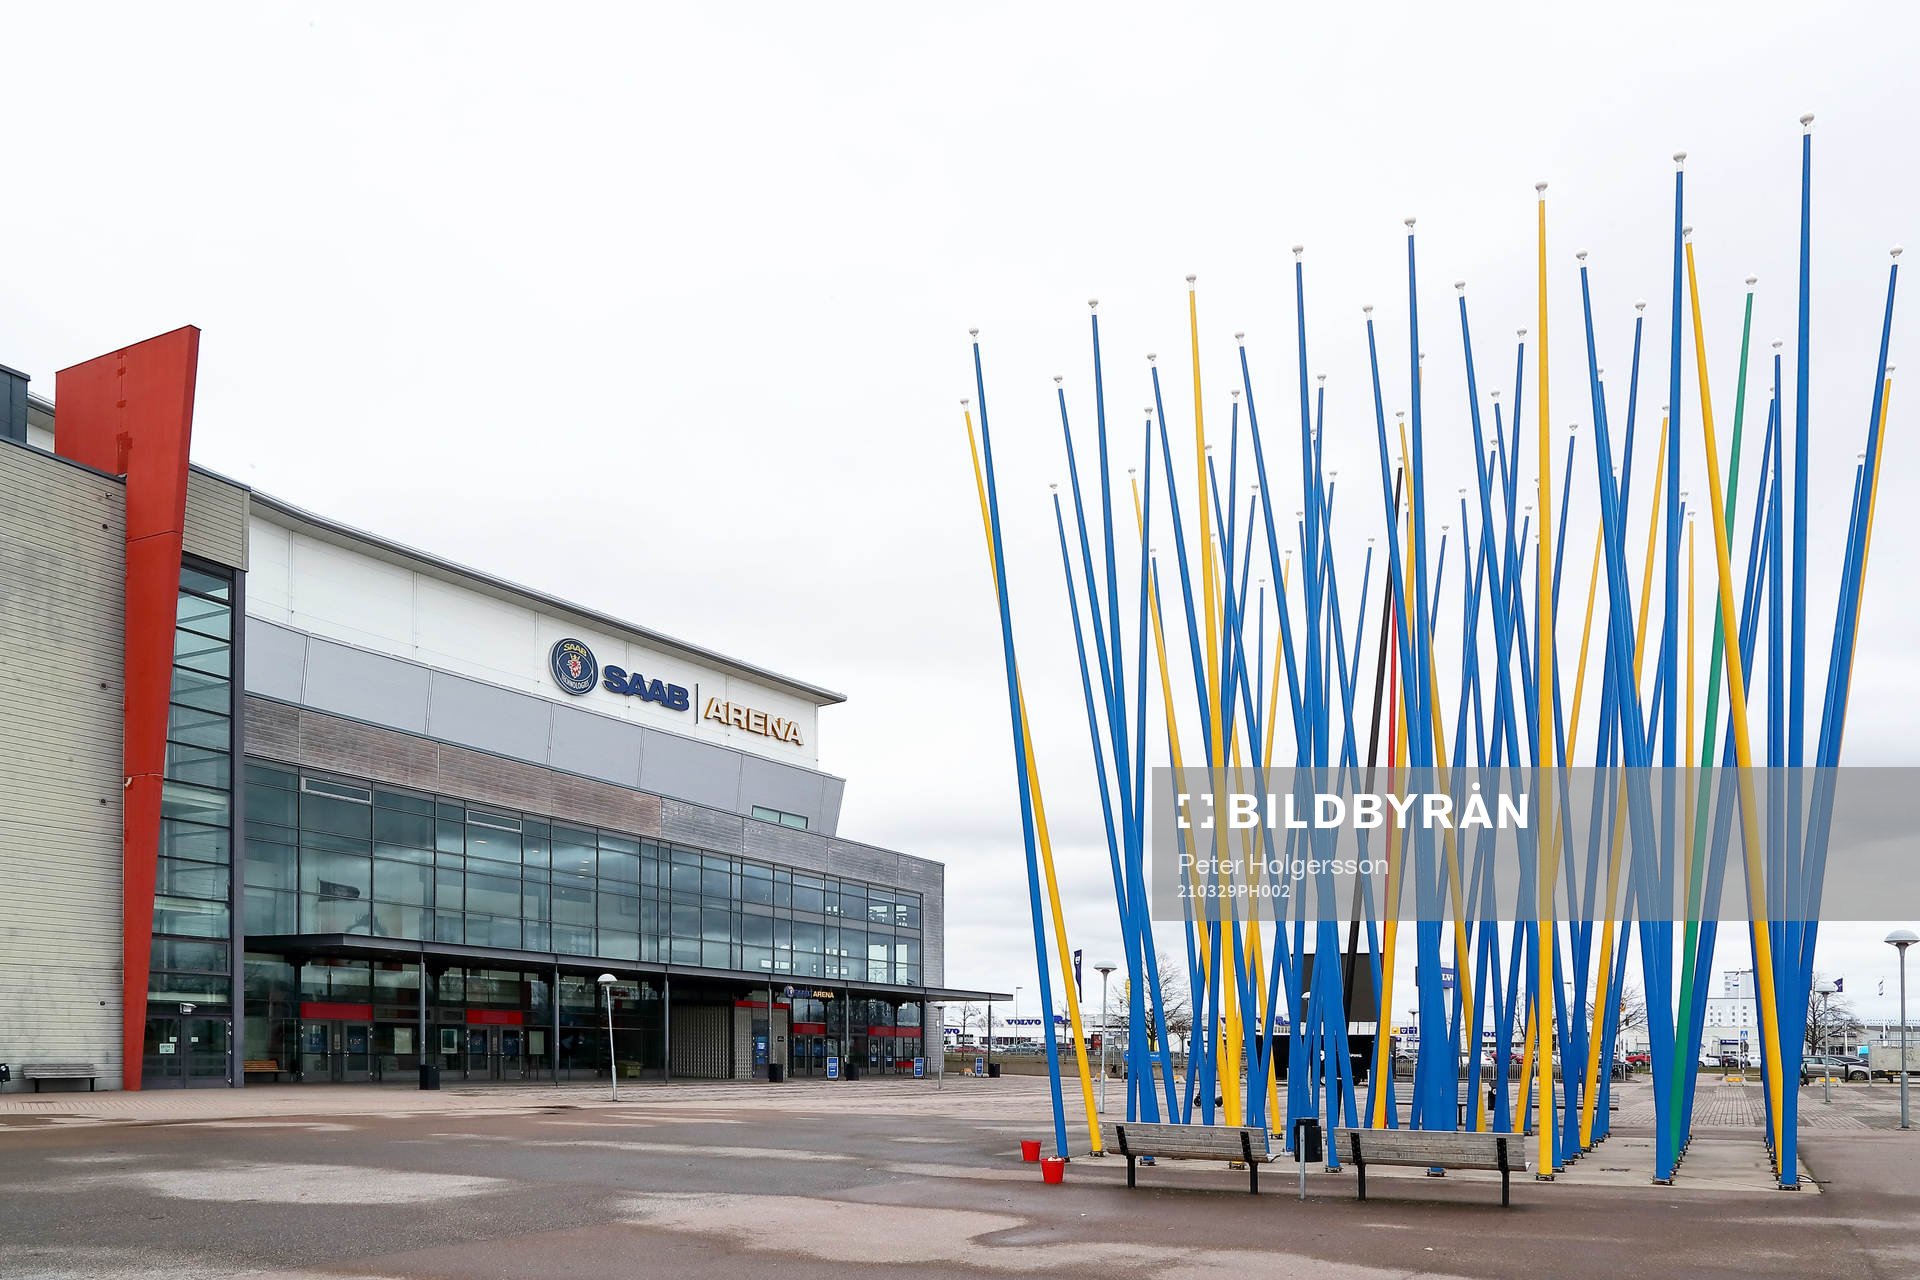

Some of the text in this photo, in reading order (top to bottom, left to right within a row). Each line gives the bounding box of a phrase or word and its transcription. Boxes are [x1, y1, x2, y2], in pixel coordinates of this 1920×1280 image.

[563, 643, 587, 657] SAAB
[603, 665, 804, 746] SAAB ARENA
[813, 990, 834, 998] ARENA
